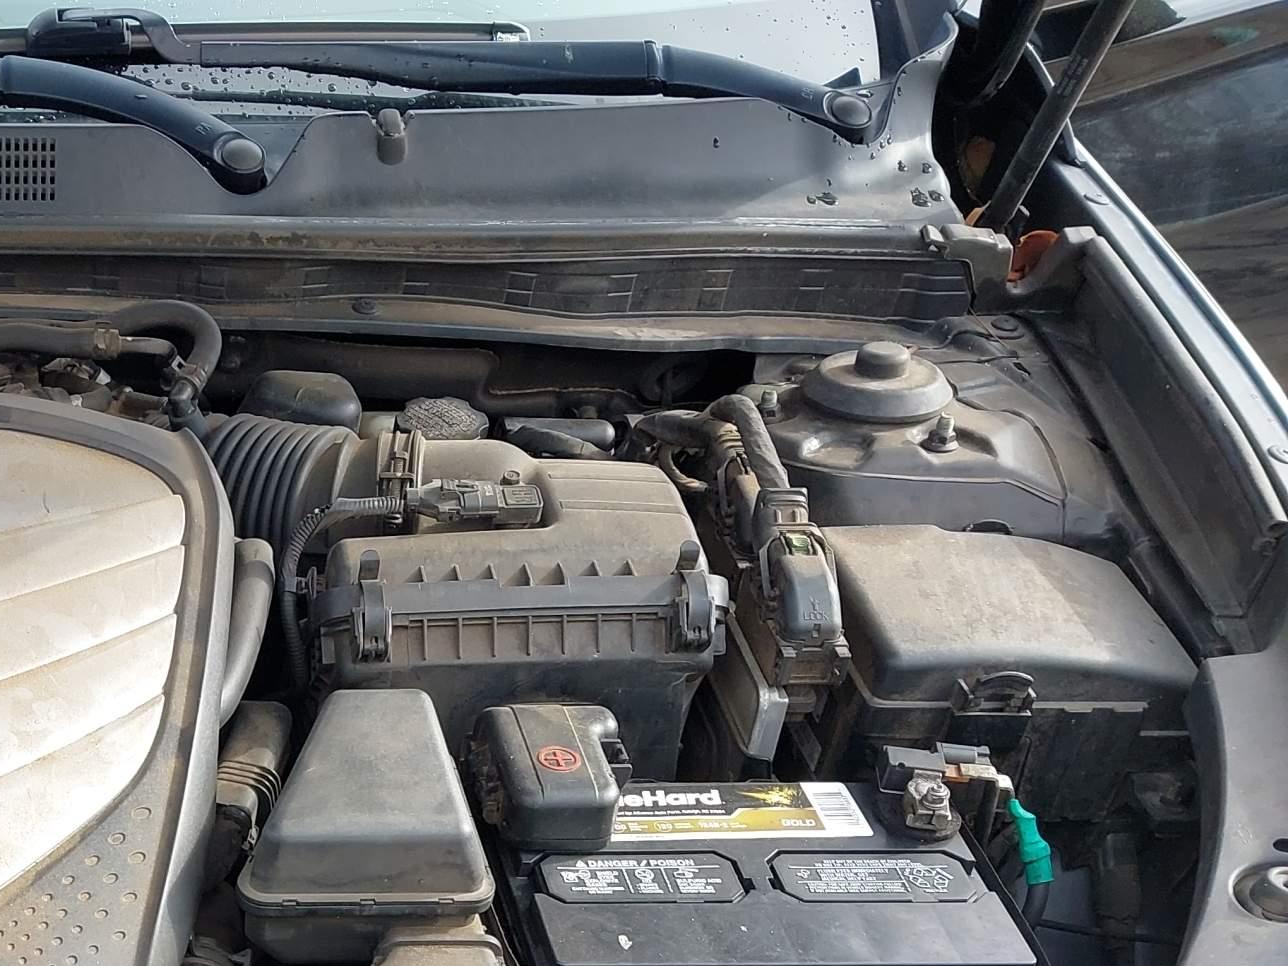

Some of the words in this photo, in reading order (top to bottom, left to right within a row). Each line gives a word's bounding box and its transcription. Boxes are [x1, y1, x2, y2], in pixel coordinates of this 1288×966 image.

[803, 610, 830, 621] LOCK
[781, 818, 816, 827] GOLD
[588, 859, 639, 867] DANGER
